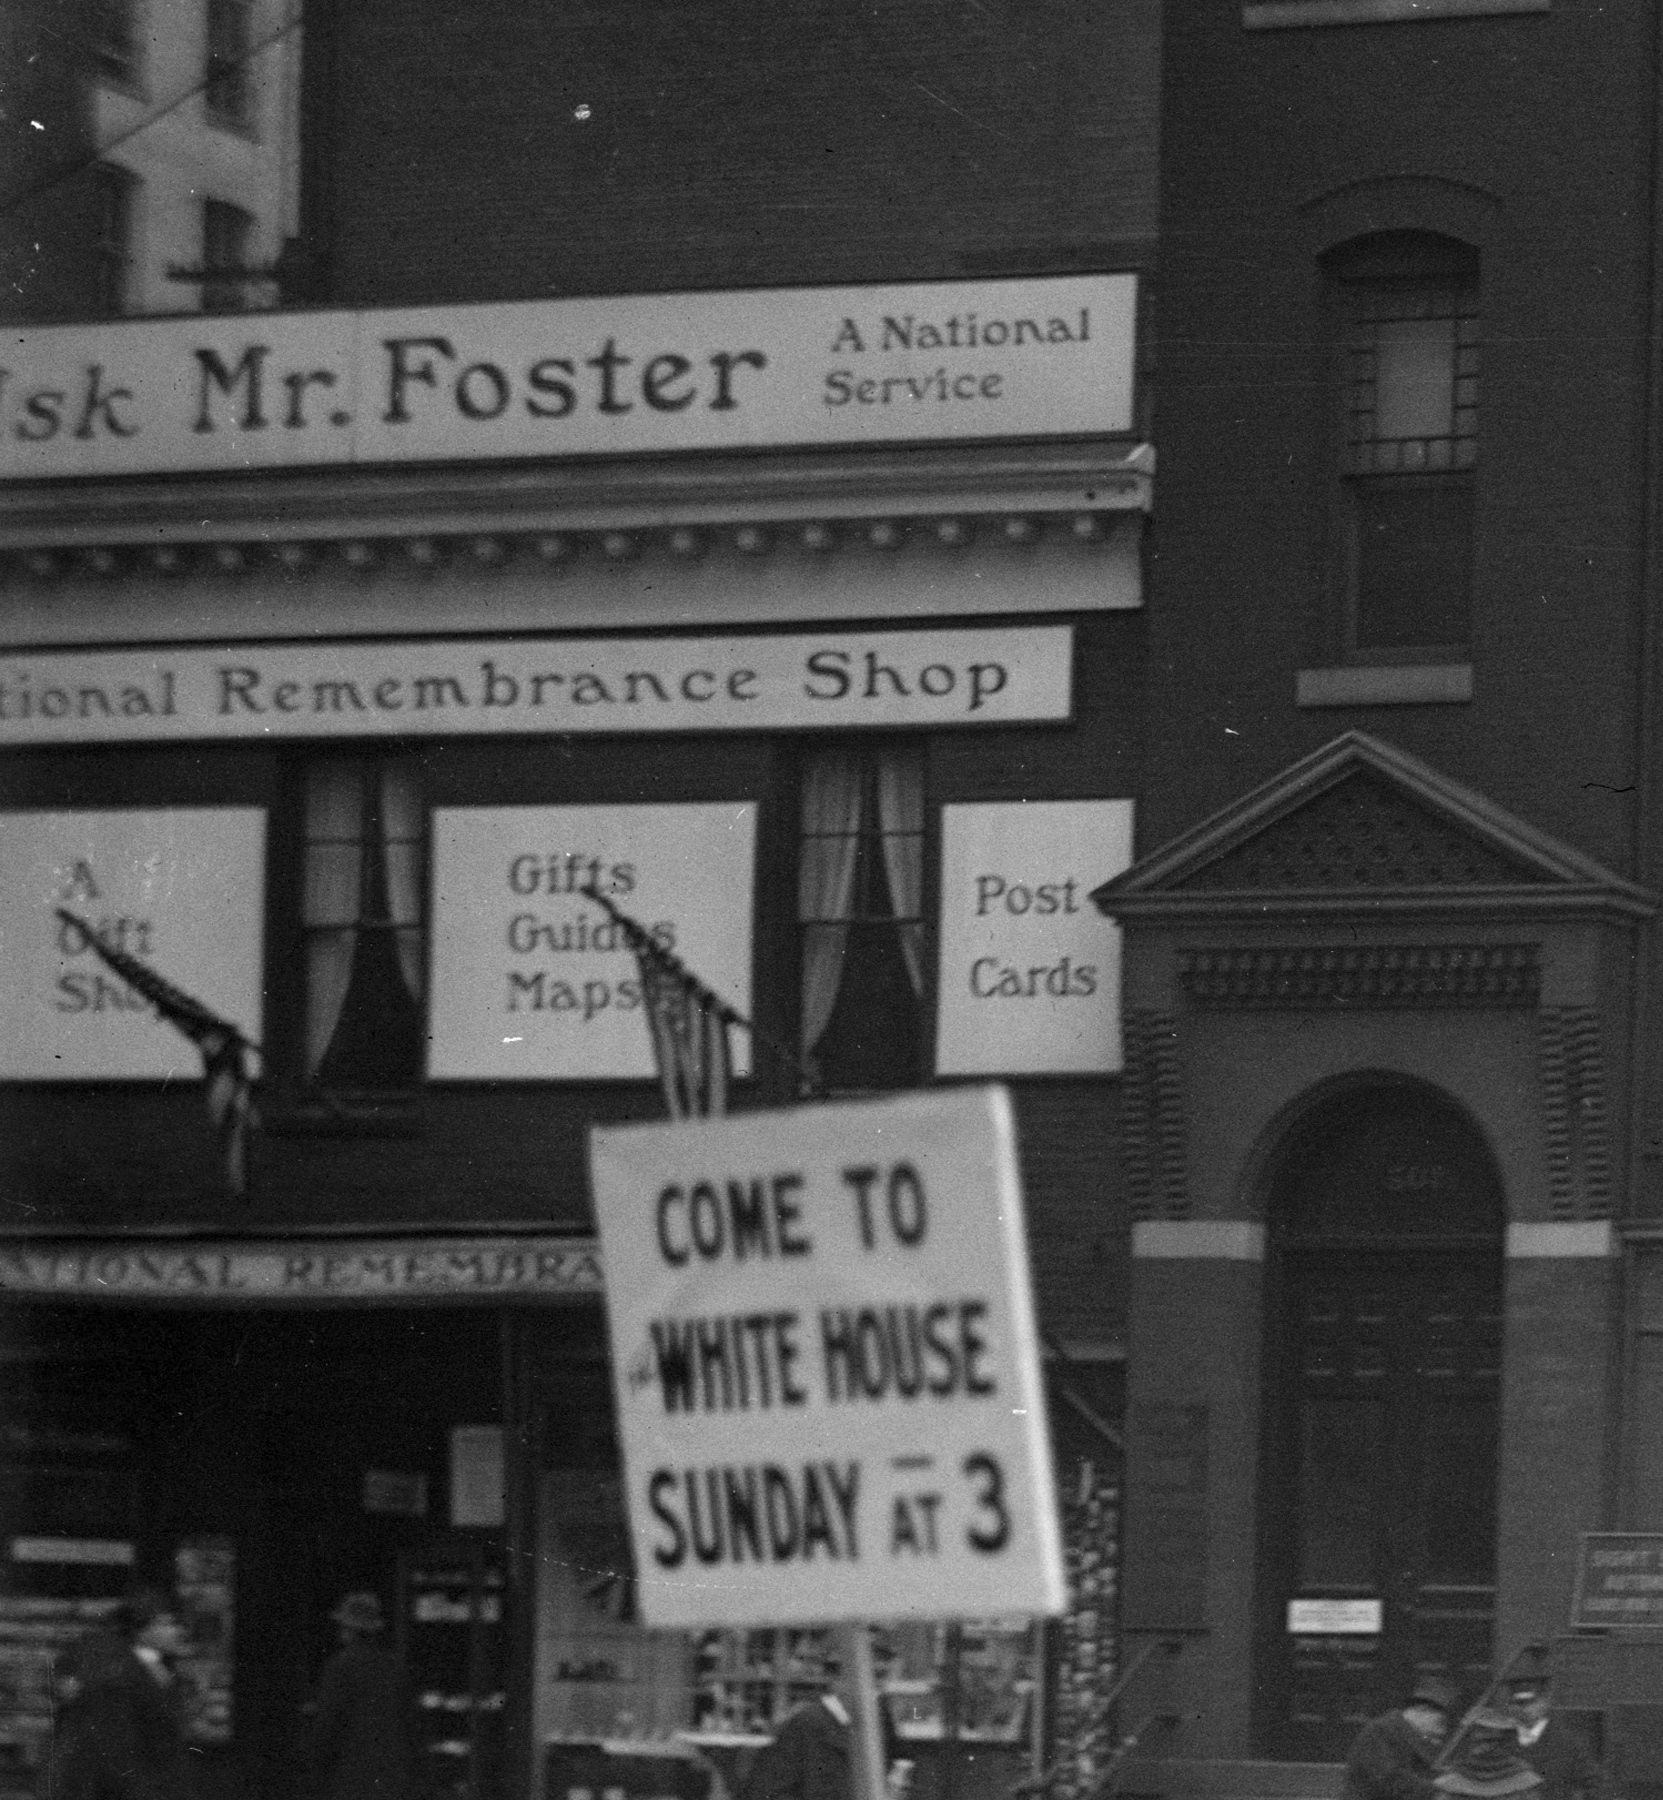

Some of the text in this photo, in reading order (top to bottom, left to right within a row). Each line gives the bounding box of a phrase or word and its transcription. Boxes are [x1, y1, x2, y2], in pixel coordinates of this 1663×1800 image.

[829, 308, 1092, 353] A National
[0, 335, 769, 442] sk Mr. Foster
[822, 366, 1006, 408] Service
[217, 660, 760, 716] Remembrance
[803, 651, 1009, 713] Shop
[508, 853, 637, 895] Gifts
[974, 873, 1081, 917] Post
[507, 912, 678, 953] Guids
[506, 970, 643, 1023] Maps
[968, 956, 1099, 998] Cards
[656, 1159, 929, 1266] COME TO
[649, 1302, 998, 1415] WHITE HOUSE
[648, 1450, 1013, 1569] SUNDAY AT 3
